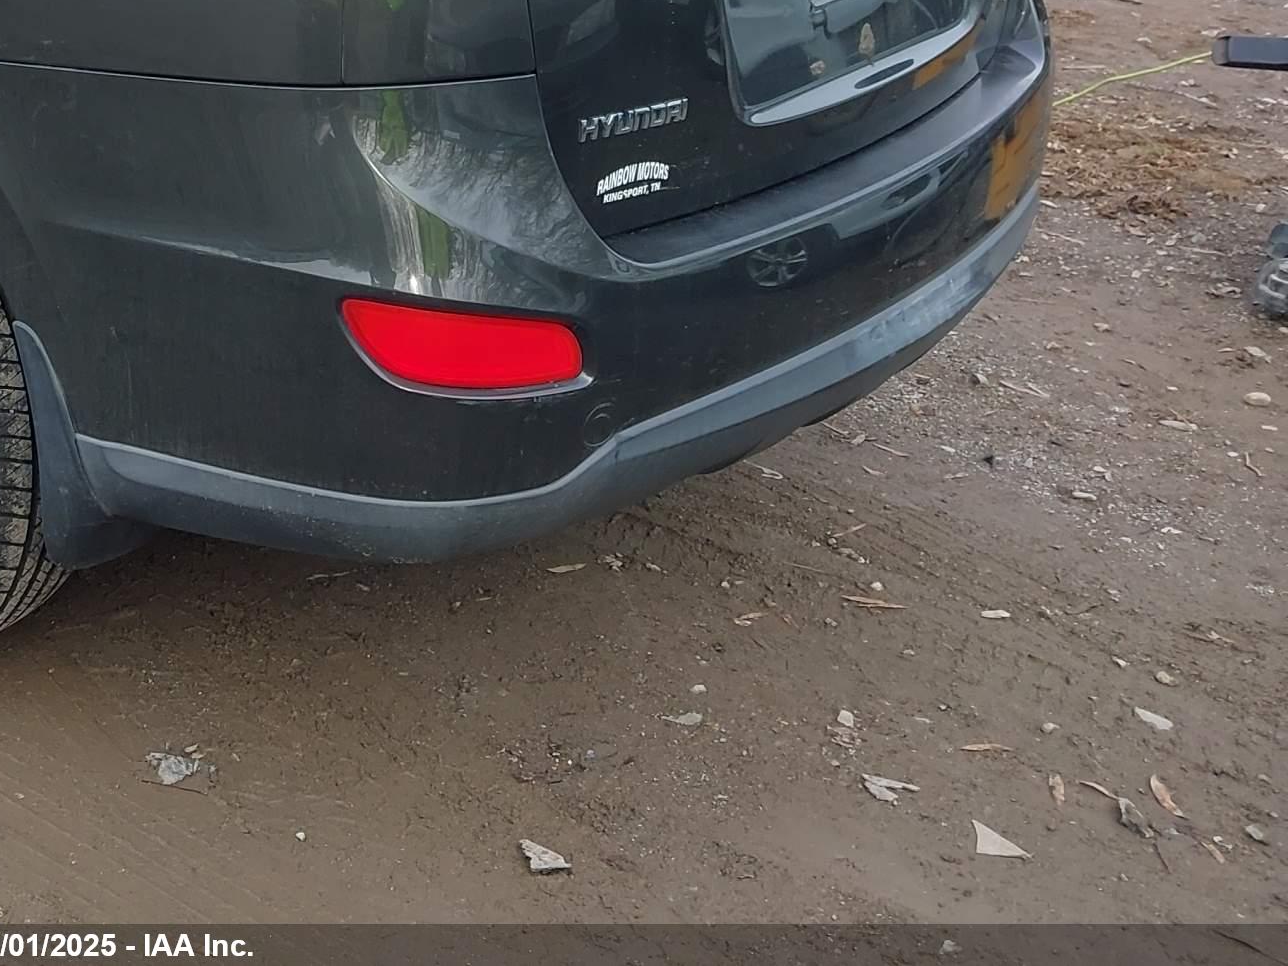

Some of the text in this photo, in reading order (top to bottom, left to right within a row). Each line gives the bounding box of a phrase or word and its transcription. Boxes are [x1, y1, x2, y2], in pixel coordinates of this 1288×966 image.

[577, 97, 689, 143] HYUNDAI
[596, 161, 670, 196] RAINBOW MOTORS
[602, 181, 662, 204] KINGSPORT, TN
